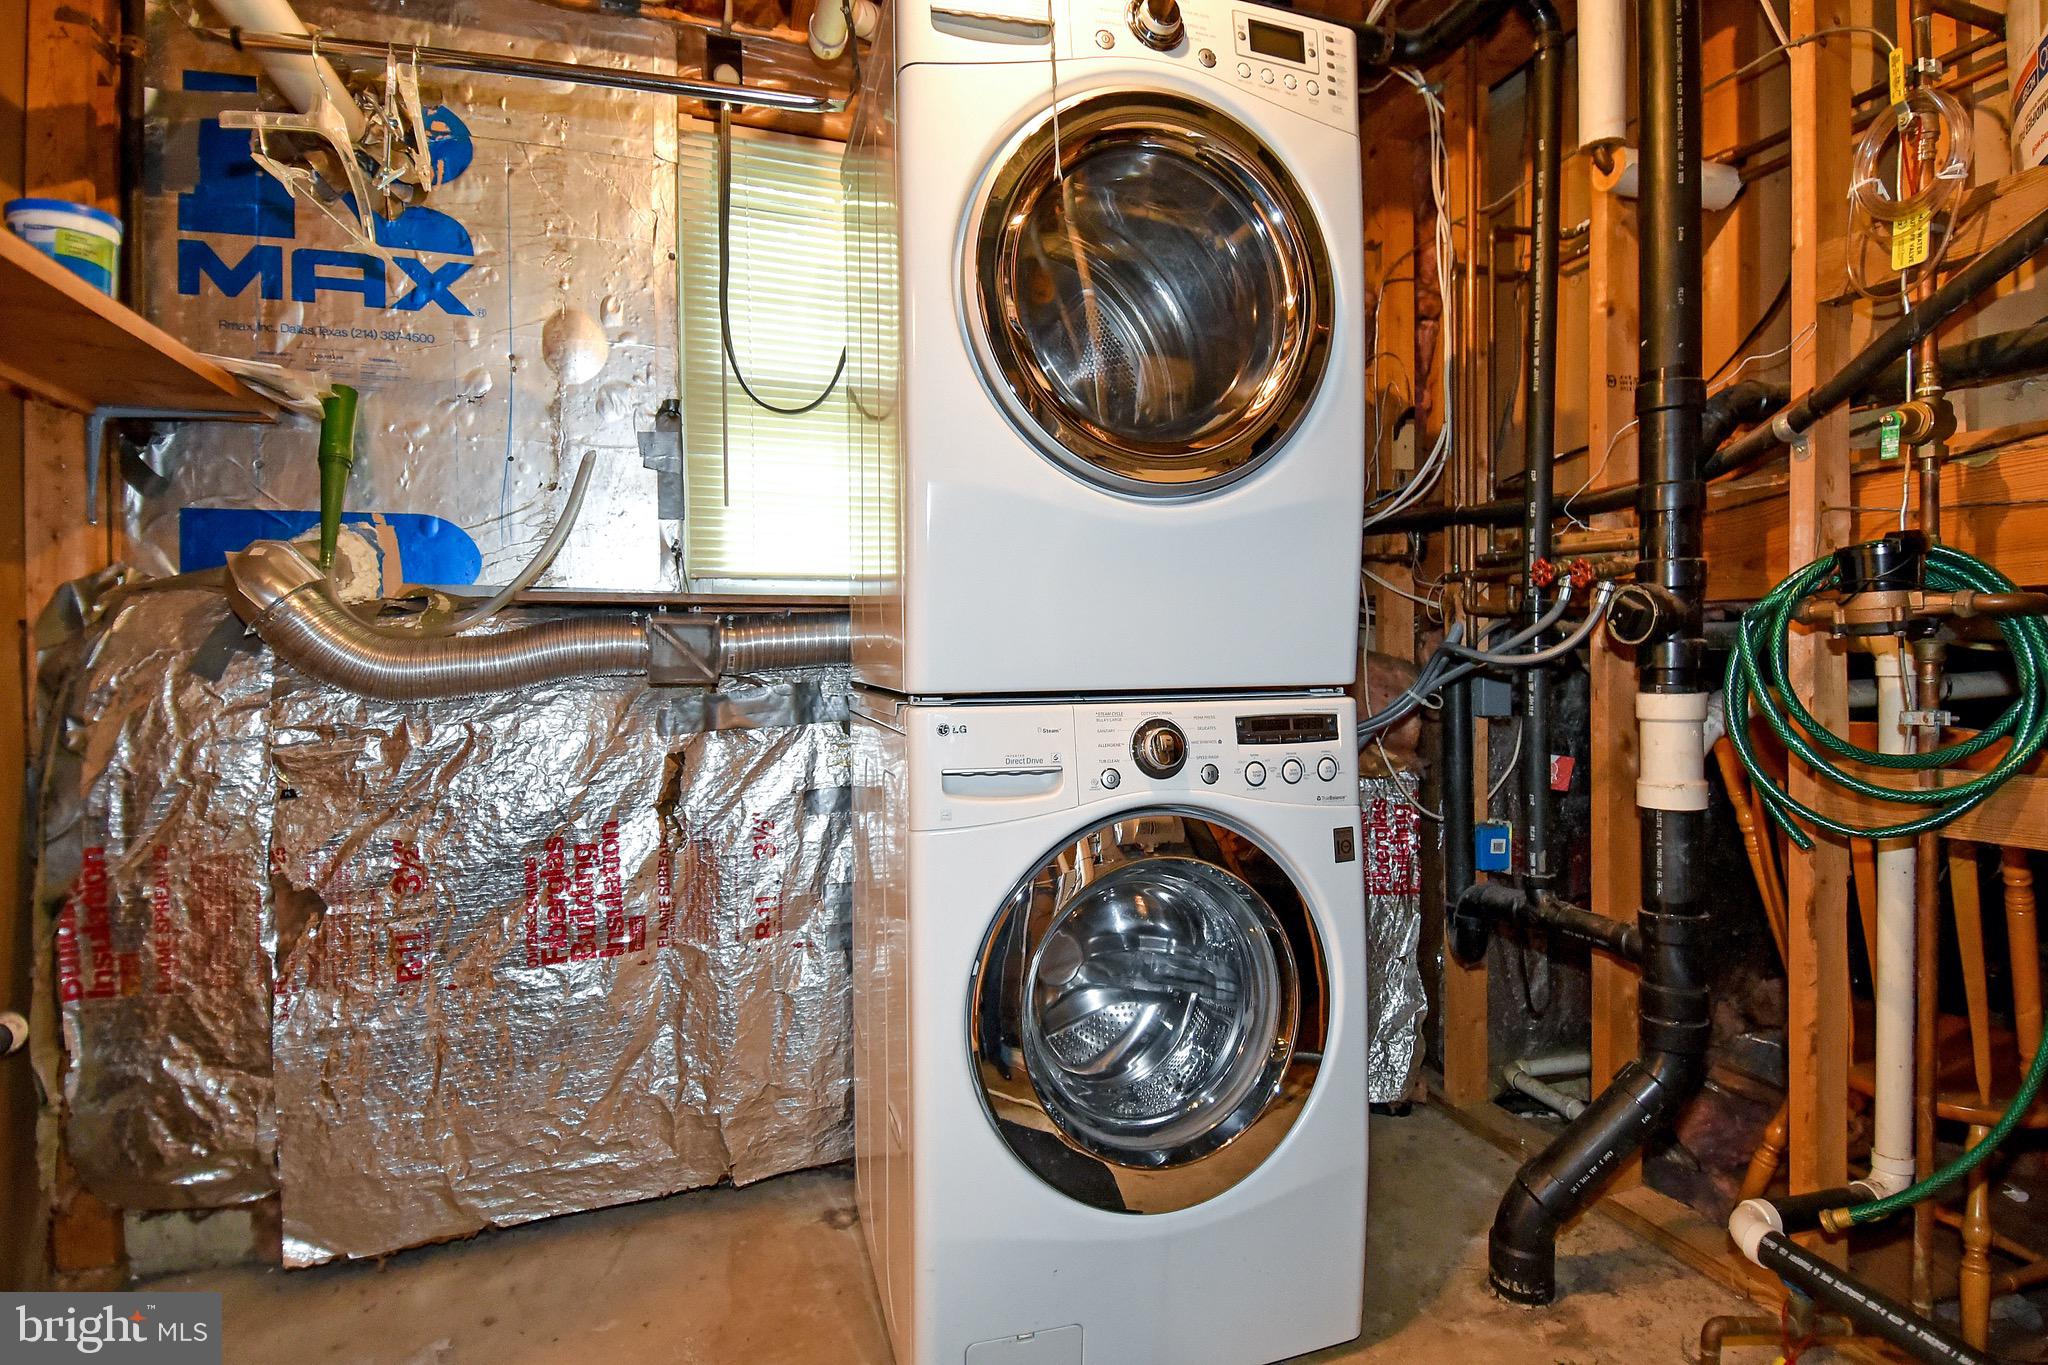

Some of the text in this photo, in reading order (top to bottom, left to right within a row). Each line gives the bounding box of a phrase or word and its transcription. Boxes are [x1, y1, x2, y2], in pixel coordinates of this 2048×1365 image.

[178, 239, 475, 316] MAX
[350, 328, 378, 340] (214)
[380, 330, 435, 344] 387-4500
[952, 725, 968, 734] LG
[570, 843, 600, 962] Building
[599, 820, 625, 958] Insulation
[657, 899, 670, 948] FLAME
